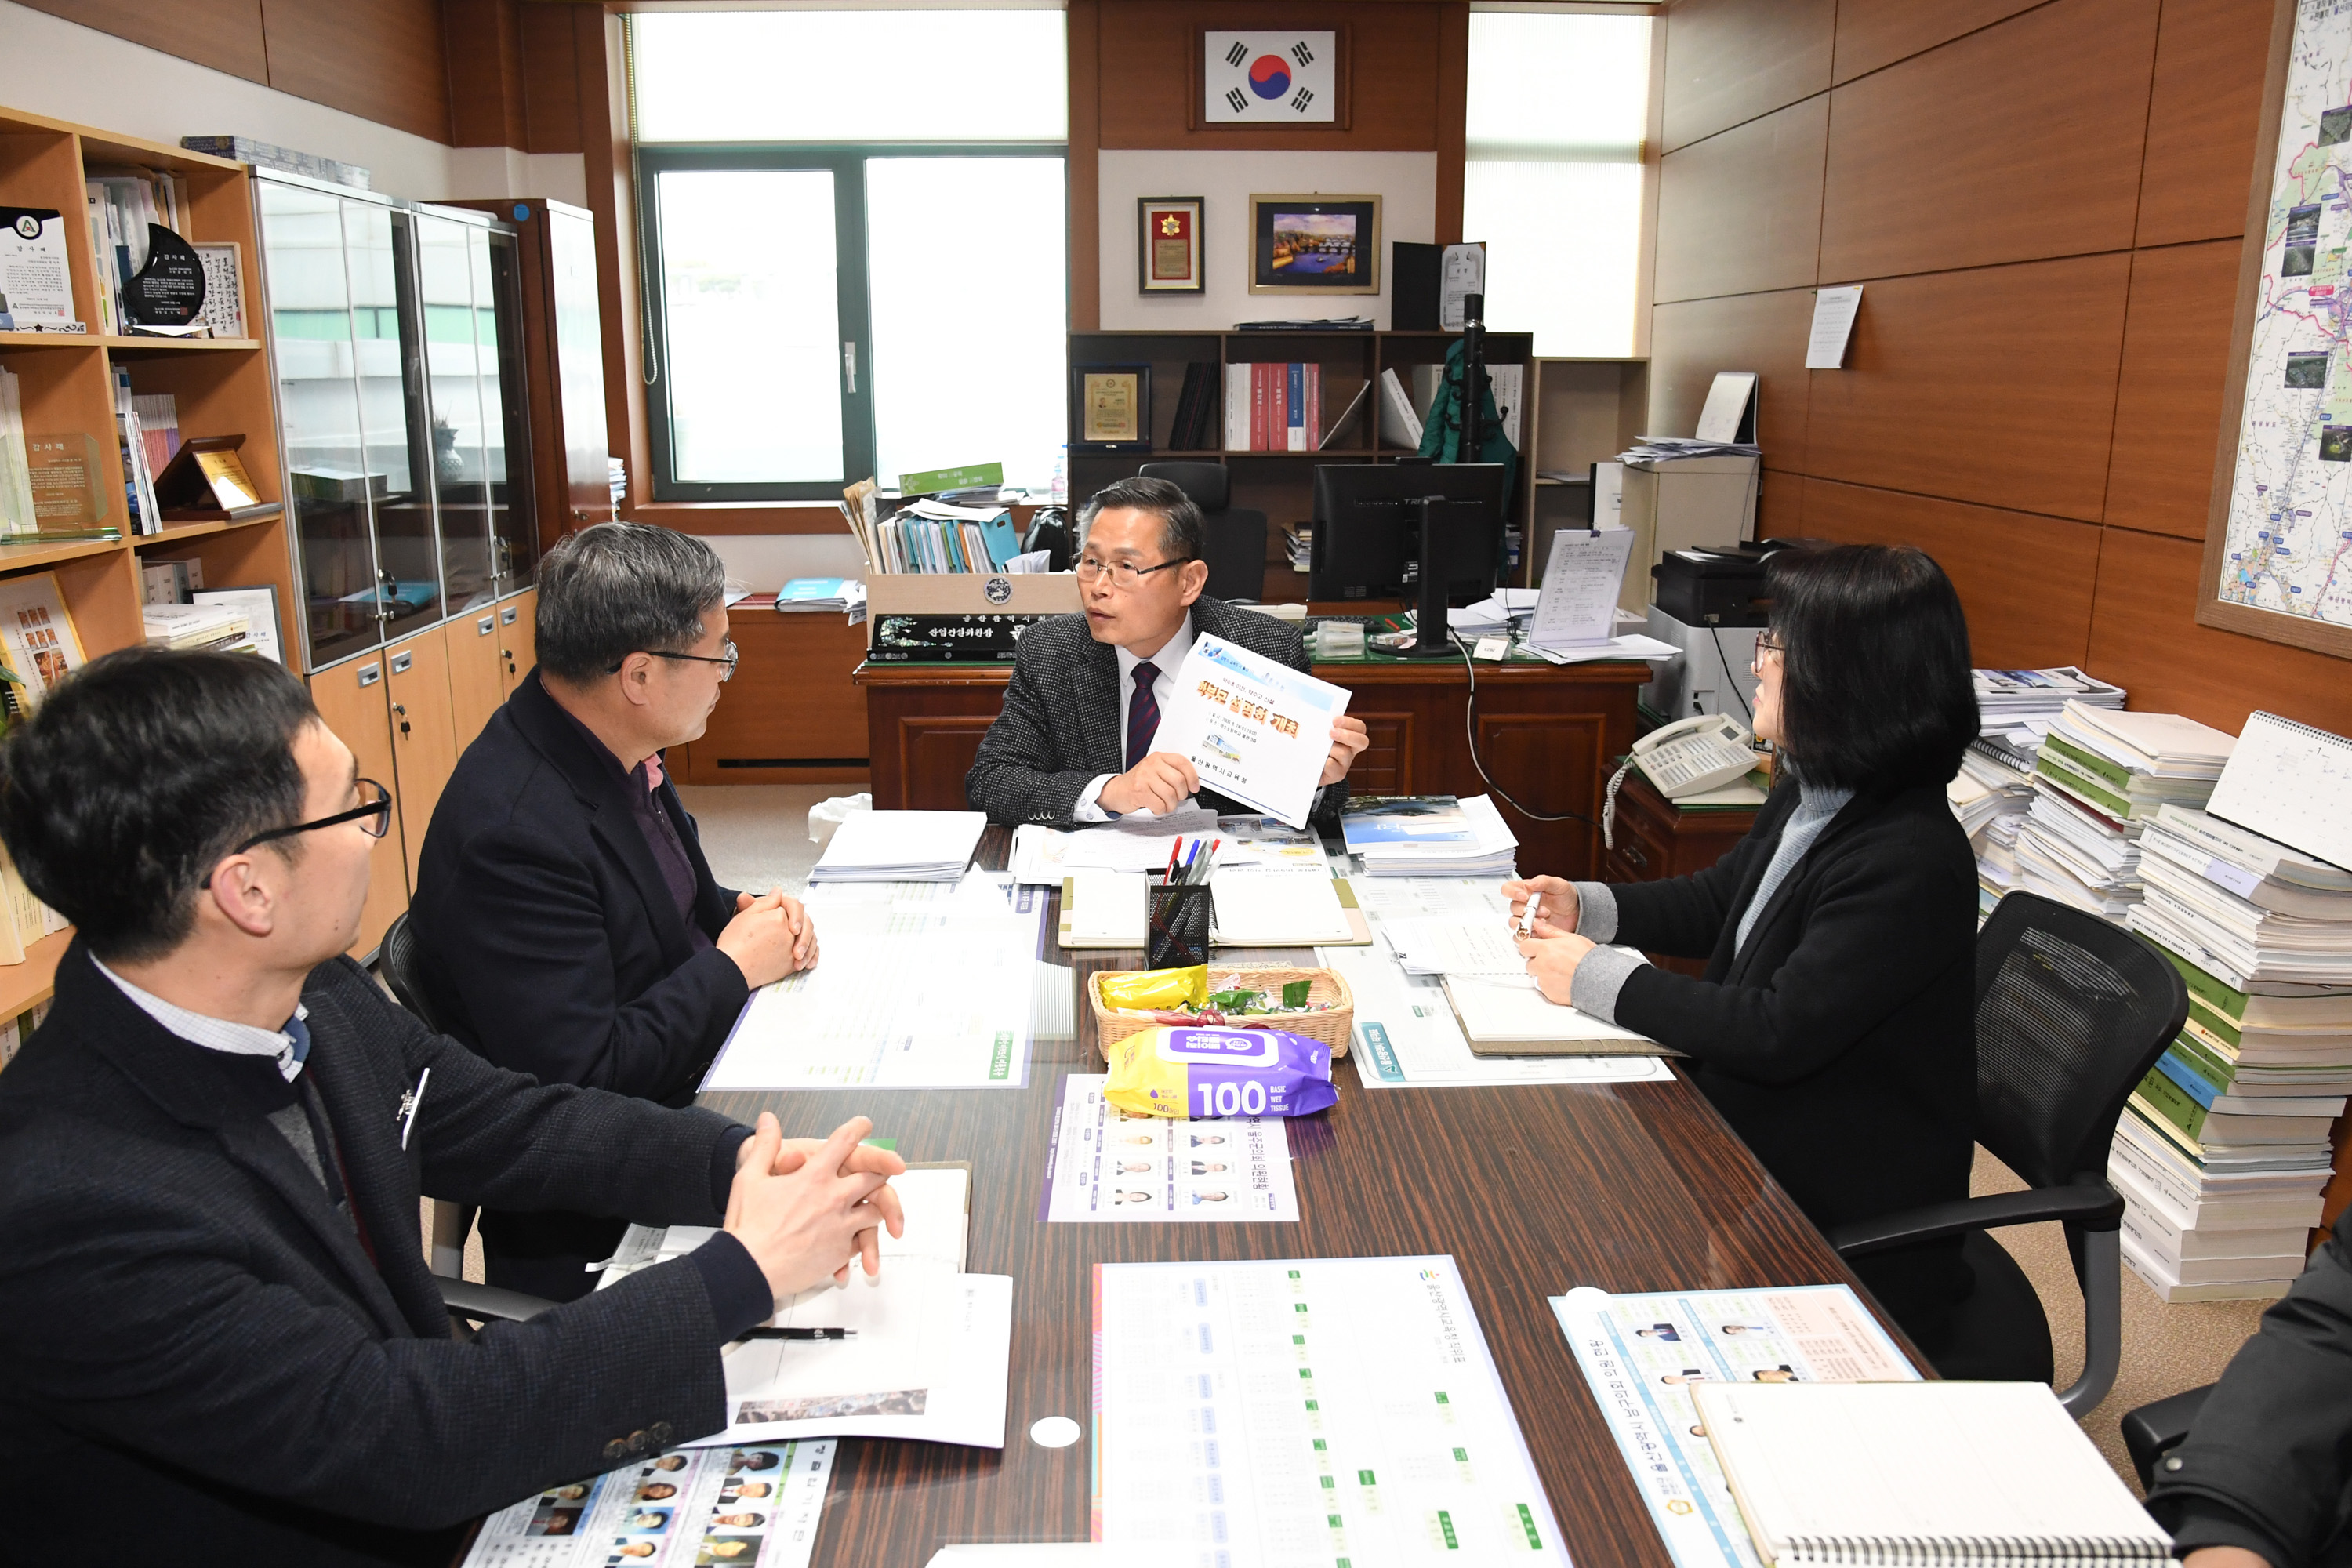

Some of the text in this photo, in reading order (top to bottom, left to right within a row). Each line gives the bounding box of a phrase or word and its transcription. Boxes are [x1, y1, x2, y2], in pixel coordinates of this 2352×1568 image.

[928, 627, 994, 638] 산업건설위원장
[1196, 680, 1301, 739] 학부모 설명회 개최
[1197, 1081, 1267, 1116] 100
[1270, 1085, 1287, 1094] BASIC
[1270, 1103, 1290, 1112] TISSUE
[1588, 1338, 1610, 1356] 현황
[1598, 1358, 1618, 1377] 의원
[1610, 1381, 1640, 1417] 남구의회
[1629, 1421, 1668, 1473] 울산광역시
